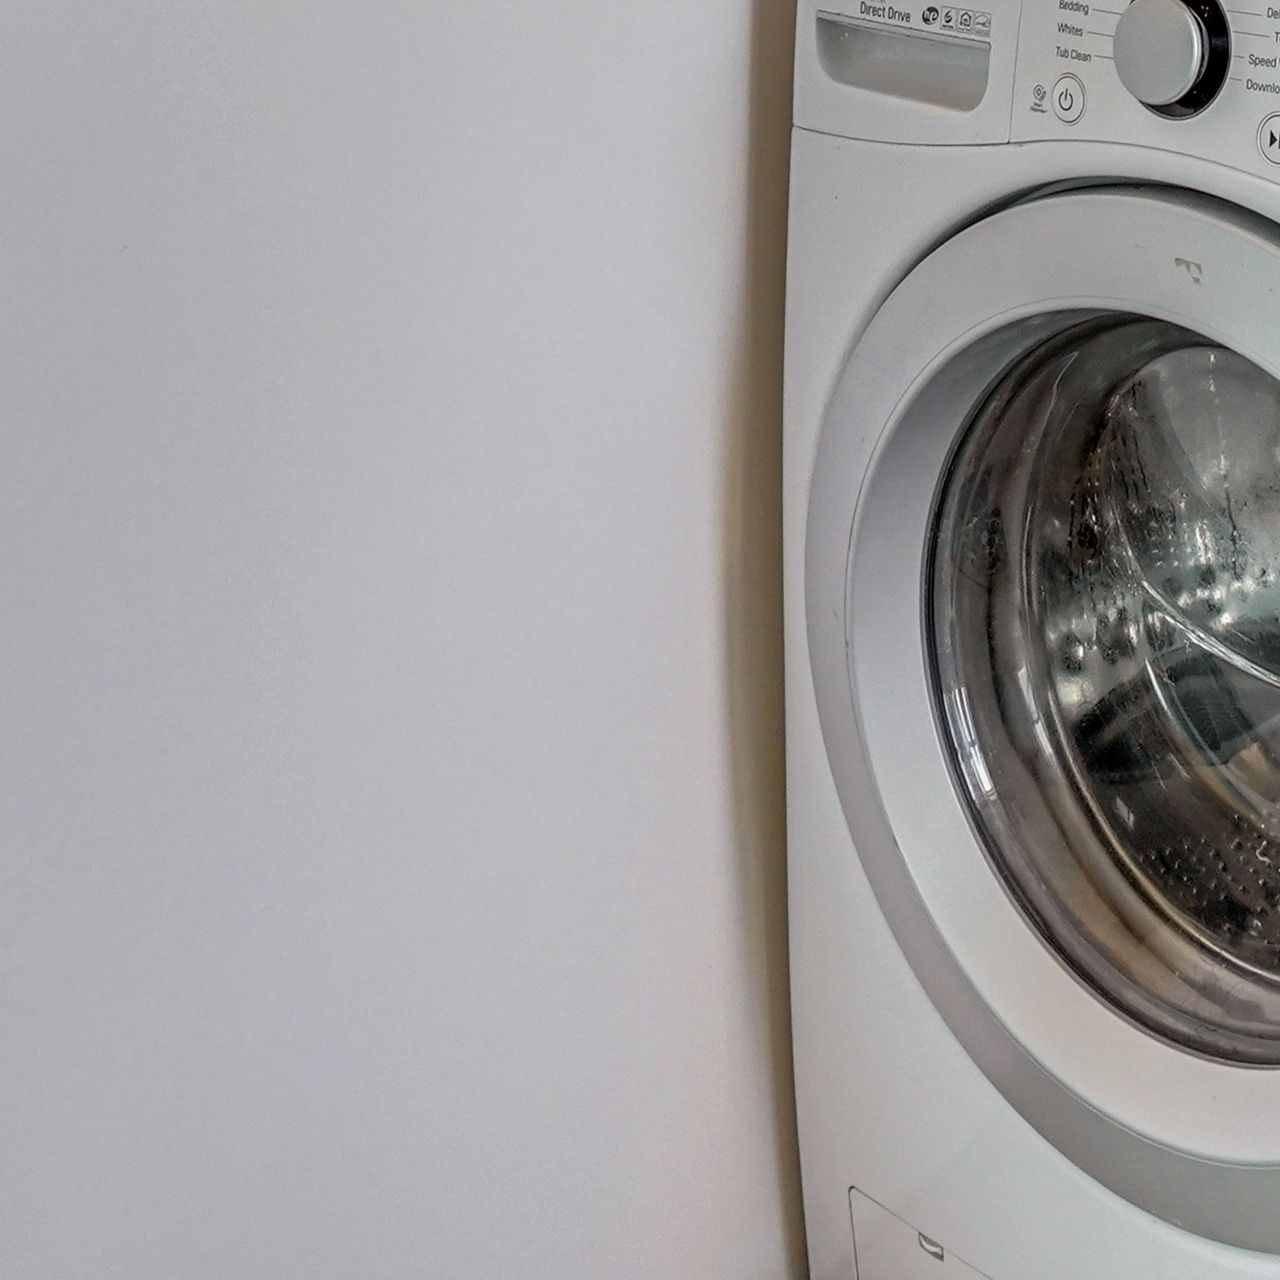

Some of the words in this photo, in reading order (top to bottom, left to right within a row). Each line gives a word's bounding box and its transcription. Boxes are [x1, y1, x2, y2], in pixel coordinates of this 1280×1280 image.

[860, 1, 886, 19] Direct
[888, 6, 911, 23] Drive
[1057, 22, 1083, 37] Whites
[1055, 45, 1069, 58] Tub
[1070, 48, 1092, 62] Clean
[1248, 53, 1277, 67] Speed
